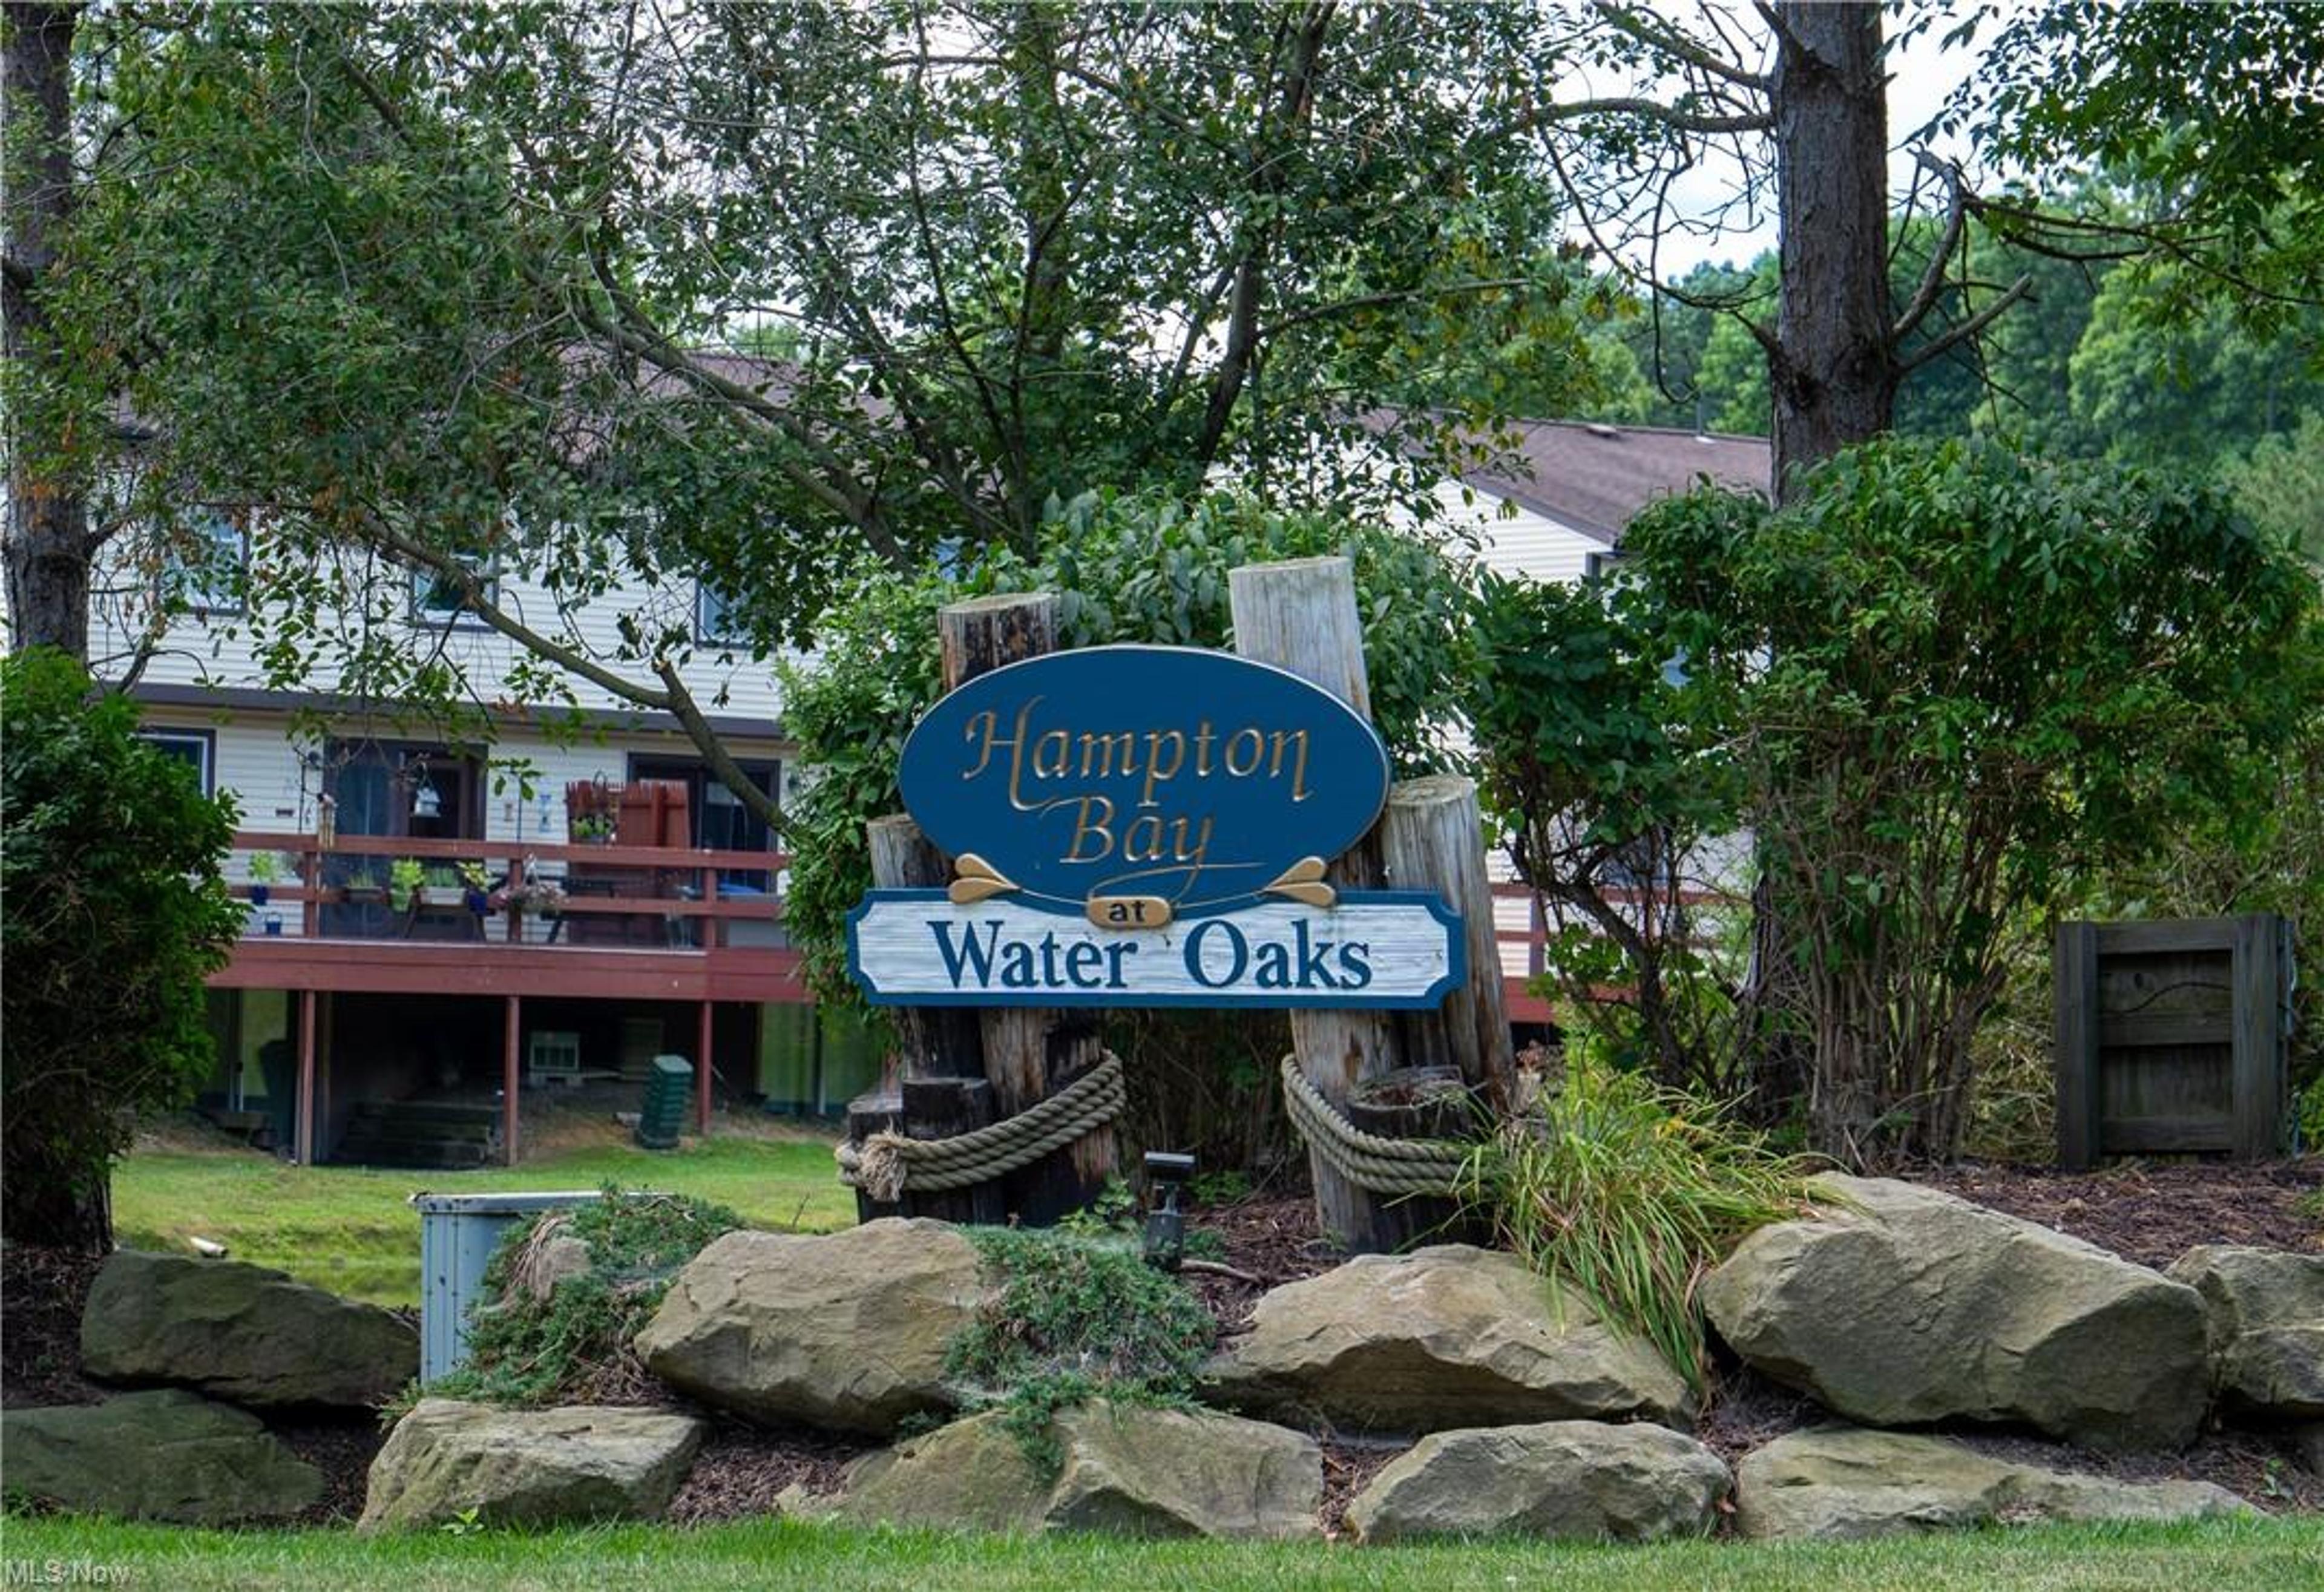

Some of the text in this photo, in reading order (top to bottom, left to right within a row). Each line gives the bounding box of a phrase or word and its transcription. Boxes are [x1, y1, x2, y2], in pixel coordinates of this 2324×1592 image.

[963, 696, 1313, 811] Hampton
[1050, 795, 1258, 898] Bay
[927, 919, 1372, 990] Water Oaks
[1109, 900, 1145, 923] at
